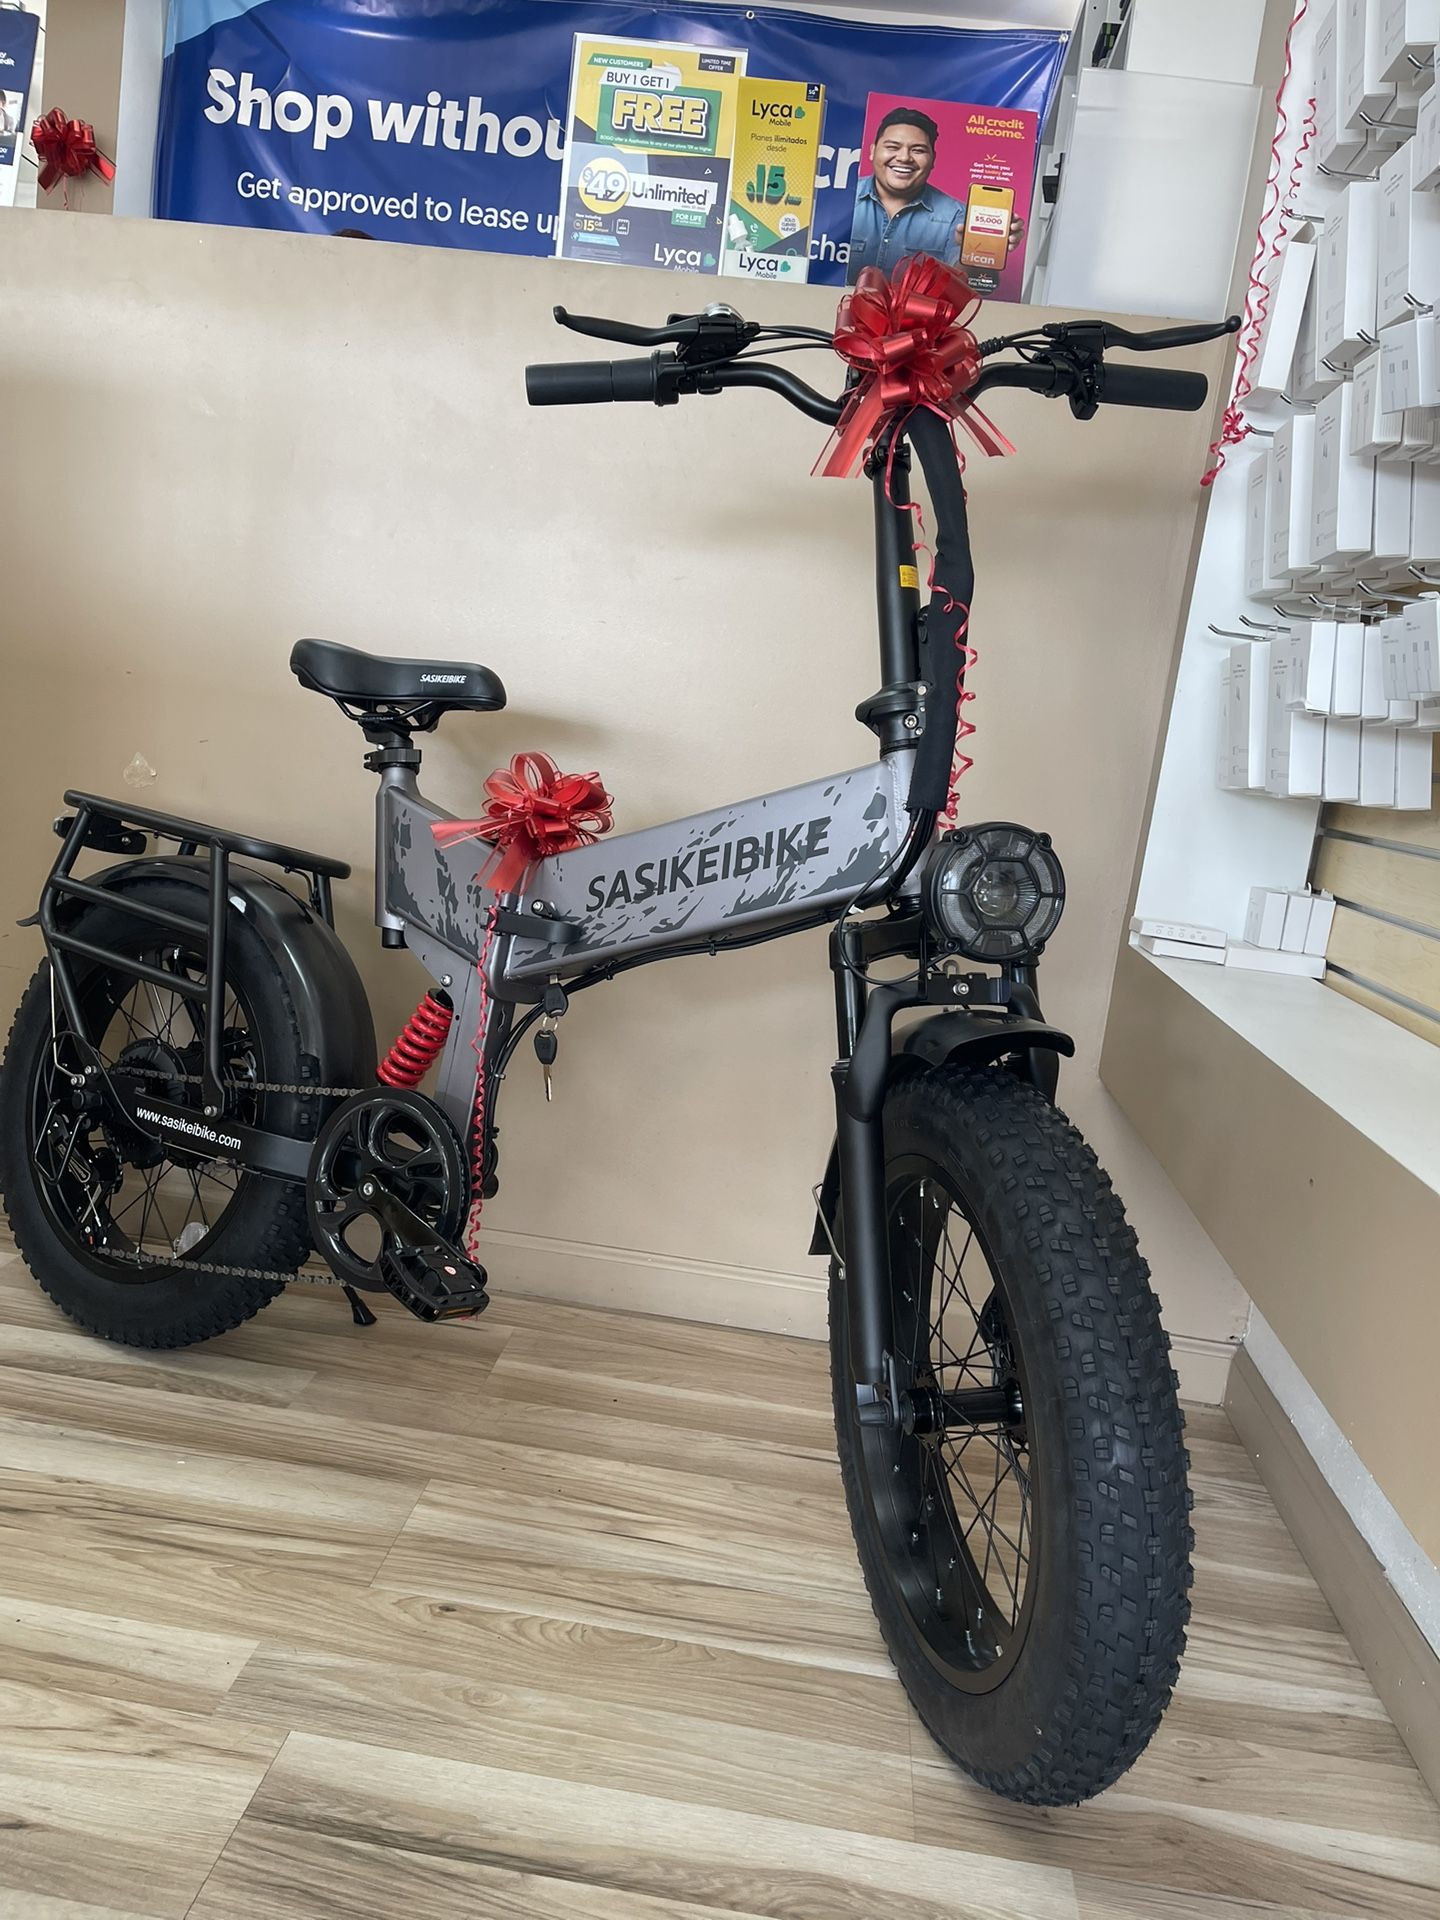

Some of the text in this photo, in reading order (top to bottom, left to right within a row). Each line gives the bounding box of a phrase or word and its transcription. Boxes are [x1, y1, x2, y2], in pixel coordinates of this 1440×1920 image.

[609, 58, 644, 68] CUSTOMERS
[701, 57, 720, 65] LIMITED
[606, 71, 631, 84] BUY
[640, 75, 664, 88] GET
[203, 68, 353, 151] Shop
[612, 90, 708, 138] FREE
[751, 99, 793, 119] Lyca
[768, 119, 791, 127] Mobile
[967, 115, 1025, 130] All credit
[751, 133, 808, 145] Planes ilimitados
[965, 126, 1025, 139] welcome.
[766, 144, 787, 152] desde
[583, 167, 627, 202] $49
[237, 171, 282, 200] Get
[287, 185, 418, 219] approved
[424, 196, 453, 222] to
[459, 197, 530, 231] lease
[632, 180, 708, 206] Unlimited
[583, 219, 595, 231] 15
[975, 215, 1002, 225] $5,000
[654, 243, 701, 266] Lyca
[739, 253, 779, 272] Lyca
[755, 271, 777, 280] Mobile
[420, 674, 467, 684] SASIKEIBIKE
[585, 815, 832, 913] SASIKEIBIKE
[136, 1107, 242, 1150] www.sasikeibike.com
